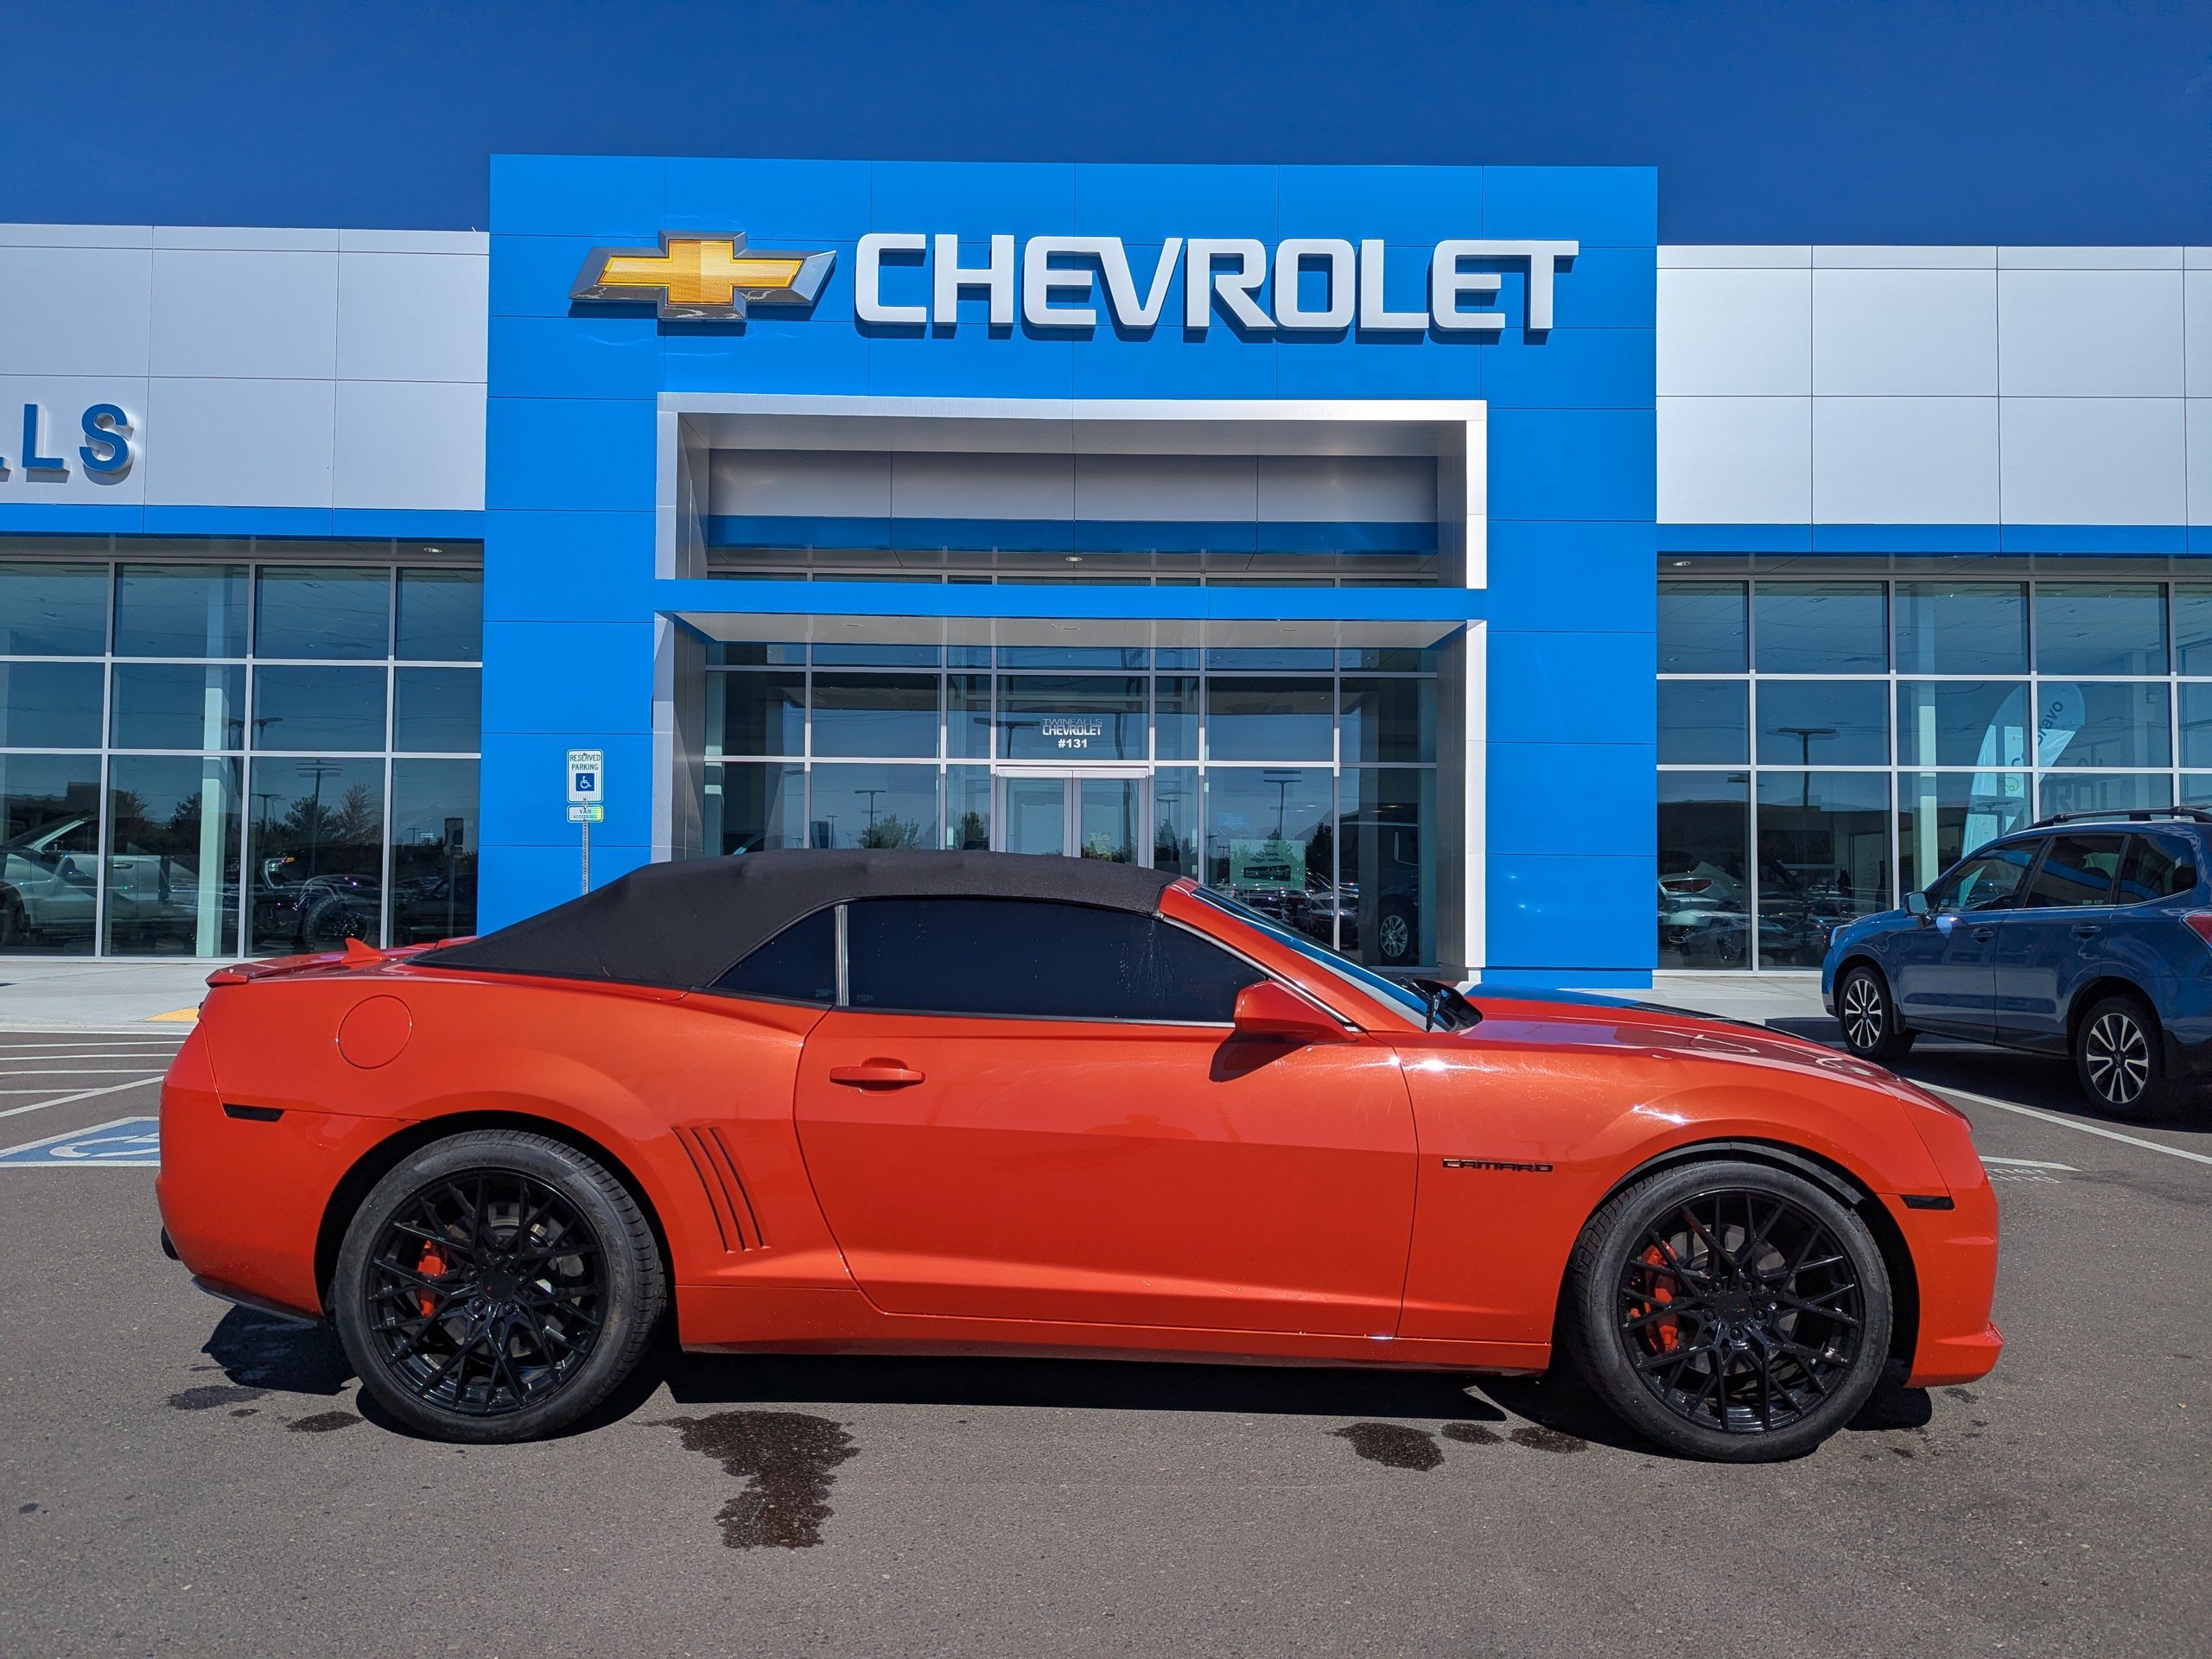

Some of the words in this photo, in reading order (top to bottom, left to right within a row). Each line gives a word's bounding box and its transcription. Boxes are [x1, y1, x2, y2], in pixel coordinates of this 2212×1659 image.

[855, 233, 1580, 332] CHEVROLET
[0, 404, 131, 472] LS
[1043, 725, 1103, 735] CHEVROLET
[1058, 739, 1088, 748] #131
[1443, 1159, 1553, 1173] CAMARO
